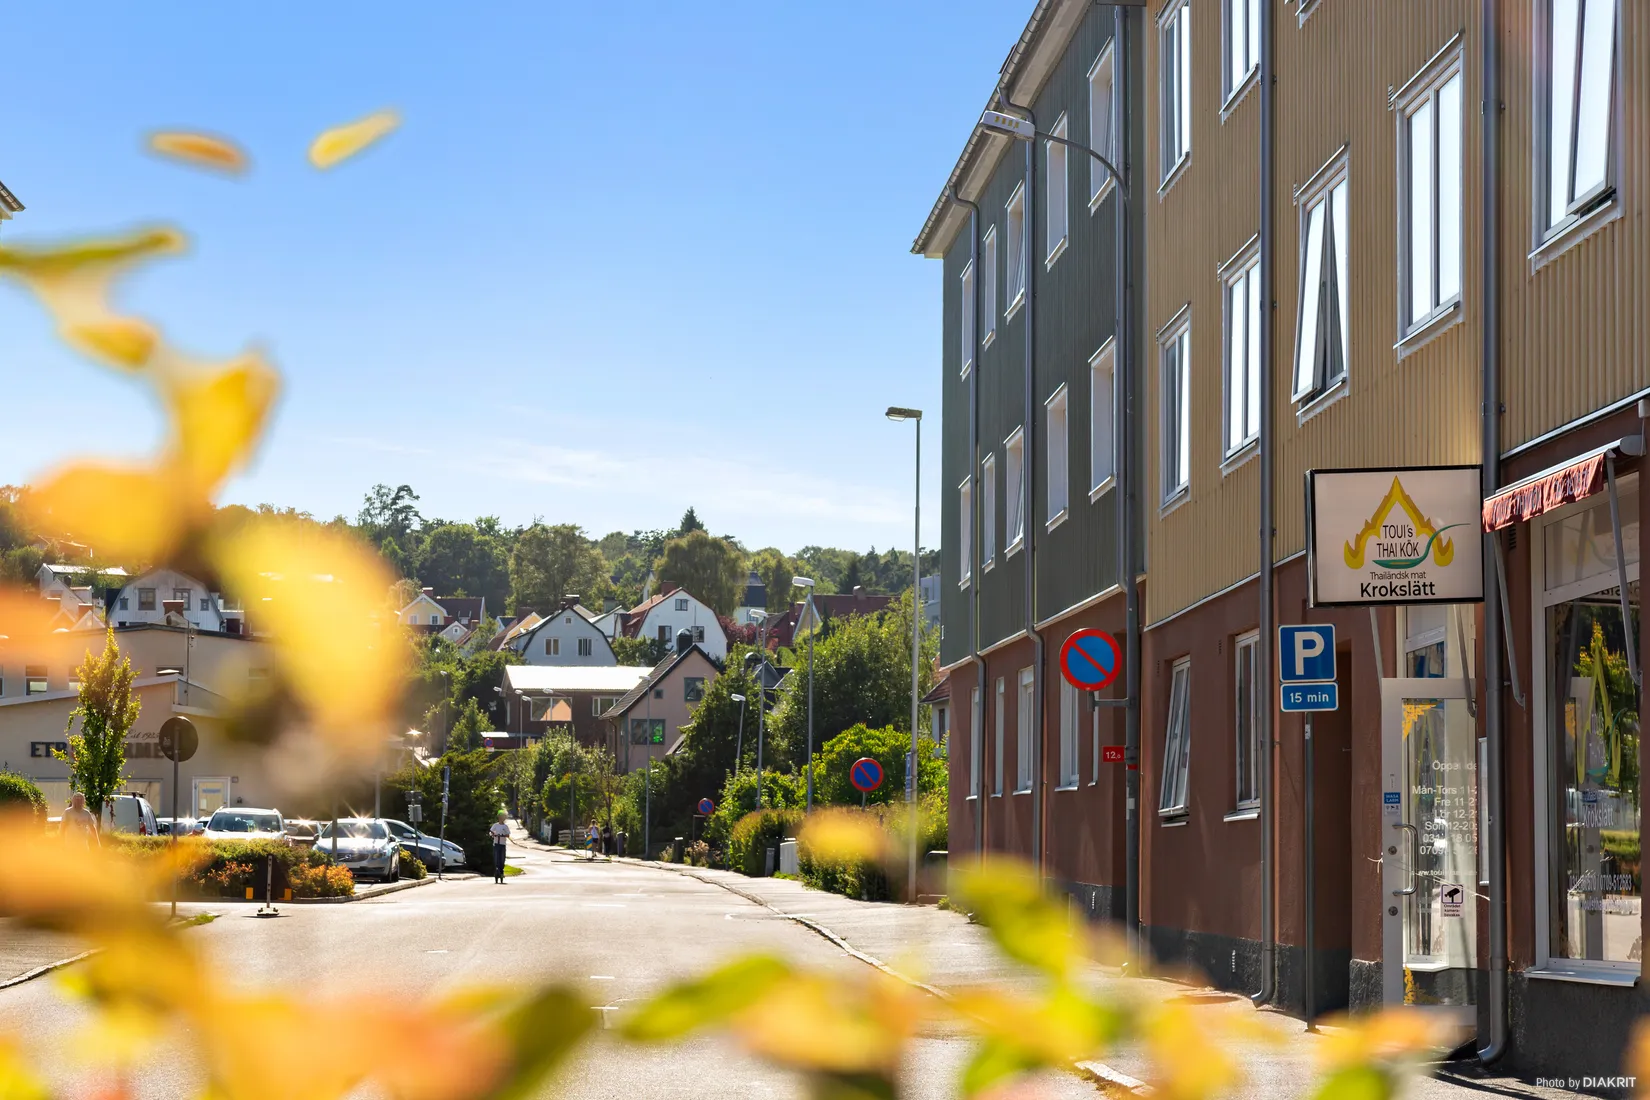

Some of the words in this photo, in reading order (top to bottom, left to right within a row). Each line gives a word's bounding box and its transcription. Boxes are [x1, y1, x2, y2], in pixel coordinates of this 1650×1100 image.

[1376, 542, 1397, 558] THAI
[1400, 540, 1420, 557] KÖK
[1370, 570, 1409, 580] Thailändsk
[1411, 571, 1426, 579] mat
[1360, 581, 1436, 598] Krokslätt
[1294, 631, 1325, 676] P
[1289, 692, 1302, 703] 15
[1307, 692, 1329, 703] min
[1434, 797, 1451, 806] Fre
[1582, 803, 1614, 828] Krokslätt
